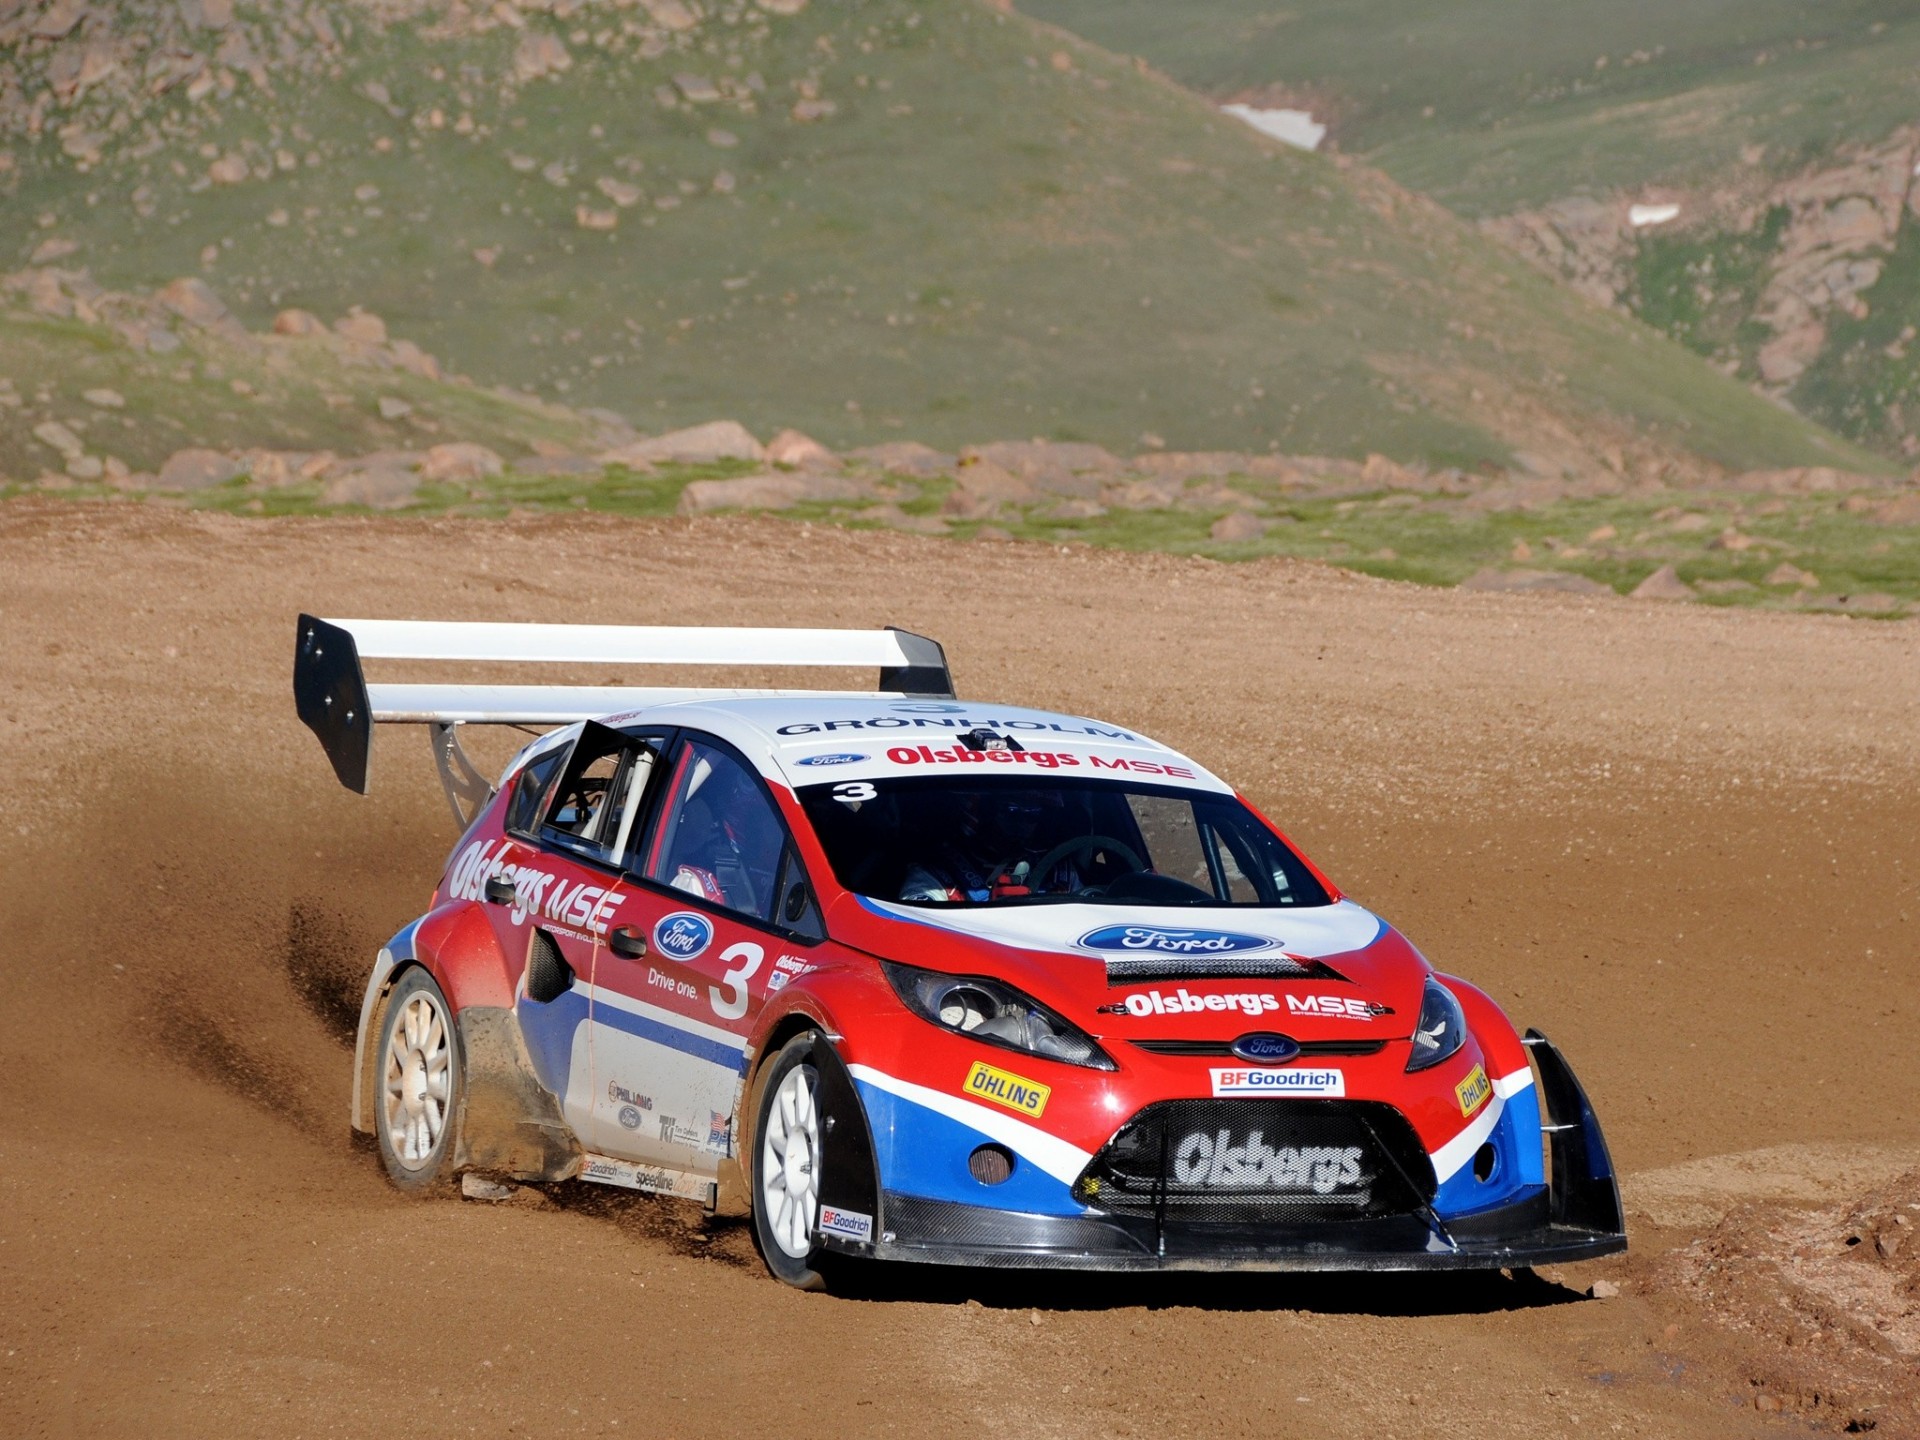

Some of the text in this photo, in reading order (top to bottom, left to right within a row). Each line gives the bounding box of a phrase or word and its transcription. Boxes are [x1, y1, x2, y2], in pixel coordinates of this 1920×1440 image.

[776, 716, 1136, 741] GRÖNHOLM
[811, 754, 854, 765] Ford
[886, 745, 1196, 780] Olsbergs MSE
[832, 782, 878, 801] 3
[545, 879, 627, 934] MSE
[662, 919, 701, 952] Ford
[1121, 927, 1235, 951] Ford
[647, 967, 699, 1000] Drive one.
[708, 941, 765, 1020] 3
[1125, 988, 1372, 1018] Olsbergs MSE
[1250, 1037, 1286, 1055] Ford
[972, 1066, 1041, 1109] ÖHLINS
[1219, 1071, 1337, 1087] BFGoodrich
[1460, 1072, 1488, 1108] ÖHLINS
[621, 1108, 638, 1126] Ford
[582, 1160, 618, 1177] BFGoodrich
[635, 1170, 674, 1191] speedline
[1174, 1129, 1363, 1194] Olsbergs
[822, 1210, 870, 1232] BFGoodrich
